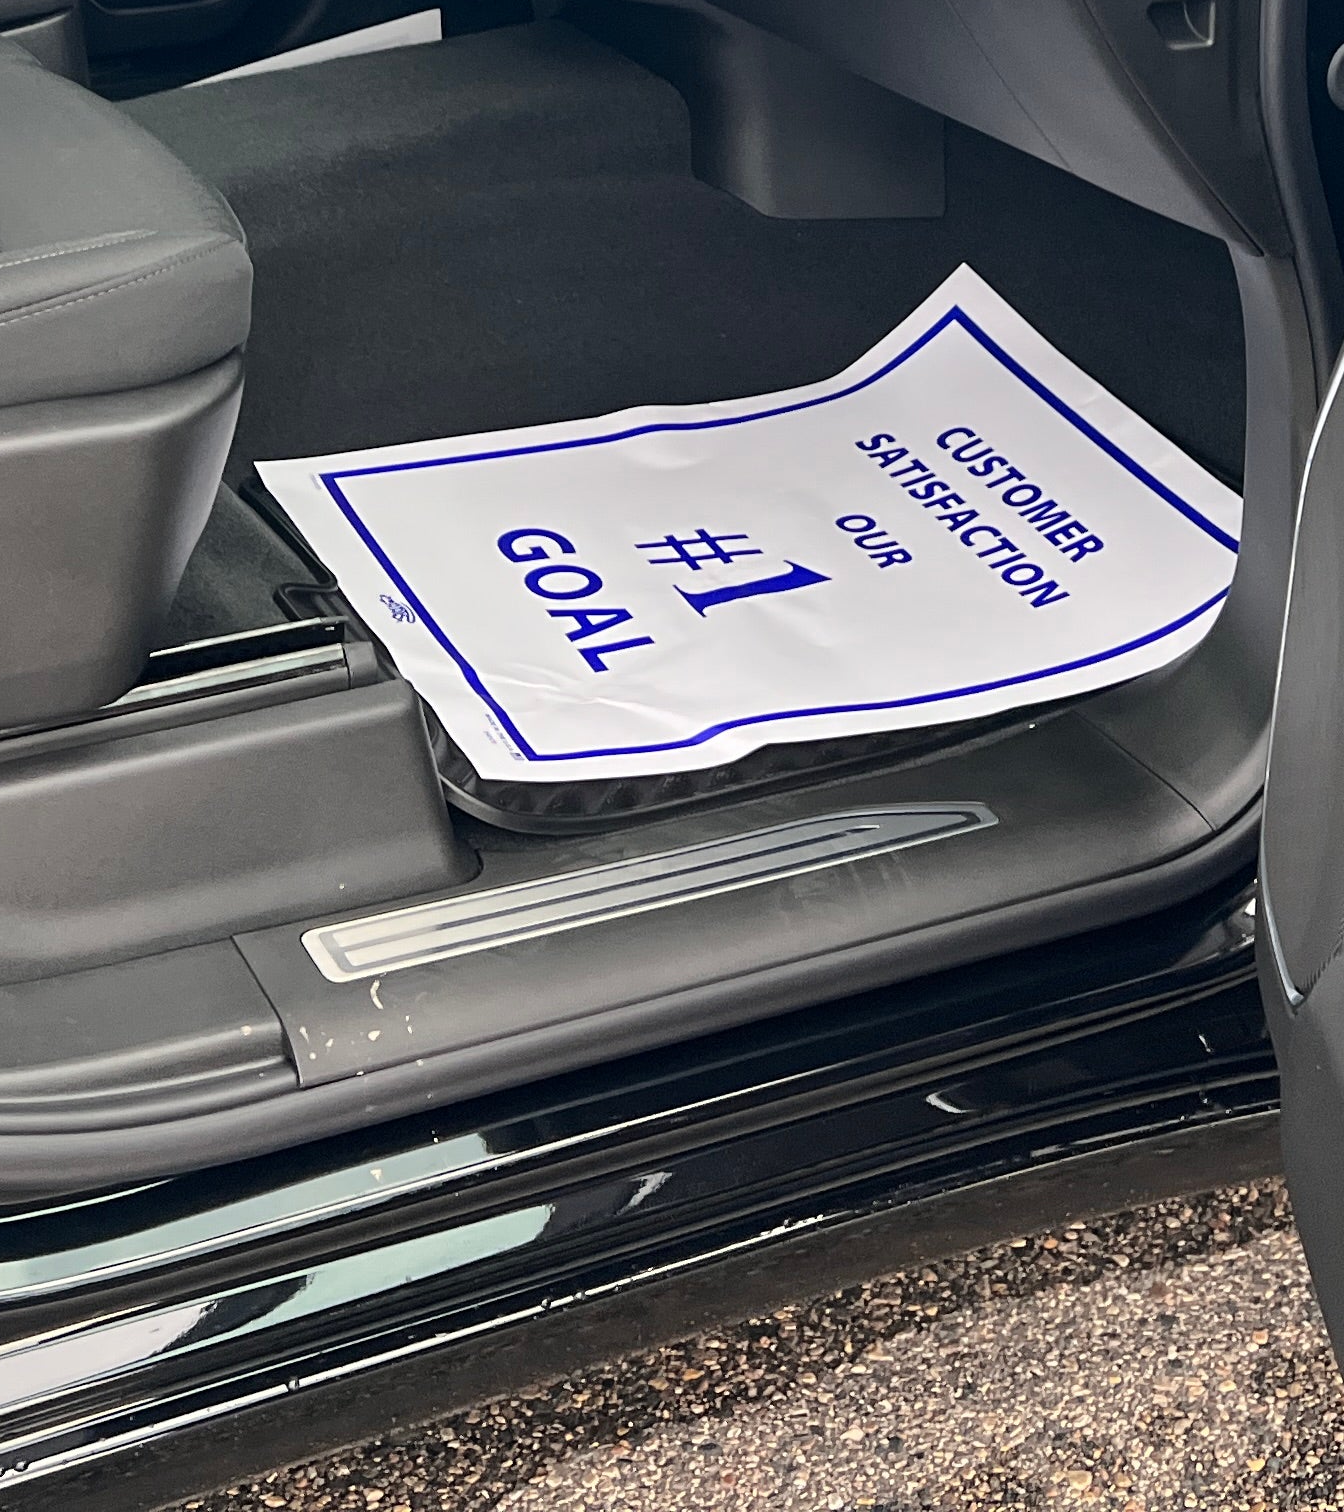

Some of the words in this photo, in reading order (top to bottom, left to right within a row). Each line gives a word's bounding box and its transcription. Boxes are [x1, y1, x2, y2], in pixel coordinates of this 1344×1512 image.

[835, 514, 913, 569] OUR
[856, 433, 1070, 608] SATISFACTION
[936, 427, 1104, 563] CUSTOMER
[497, 528, 655, 673] GOAL
[635, 528, 832, 616] #1
